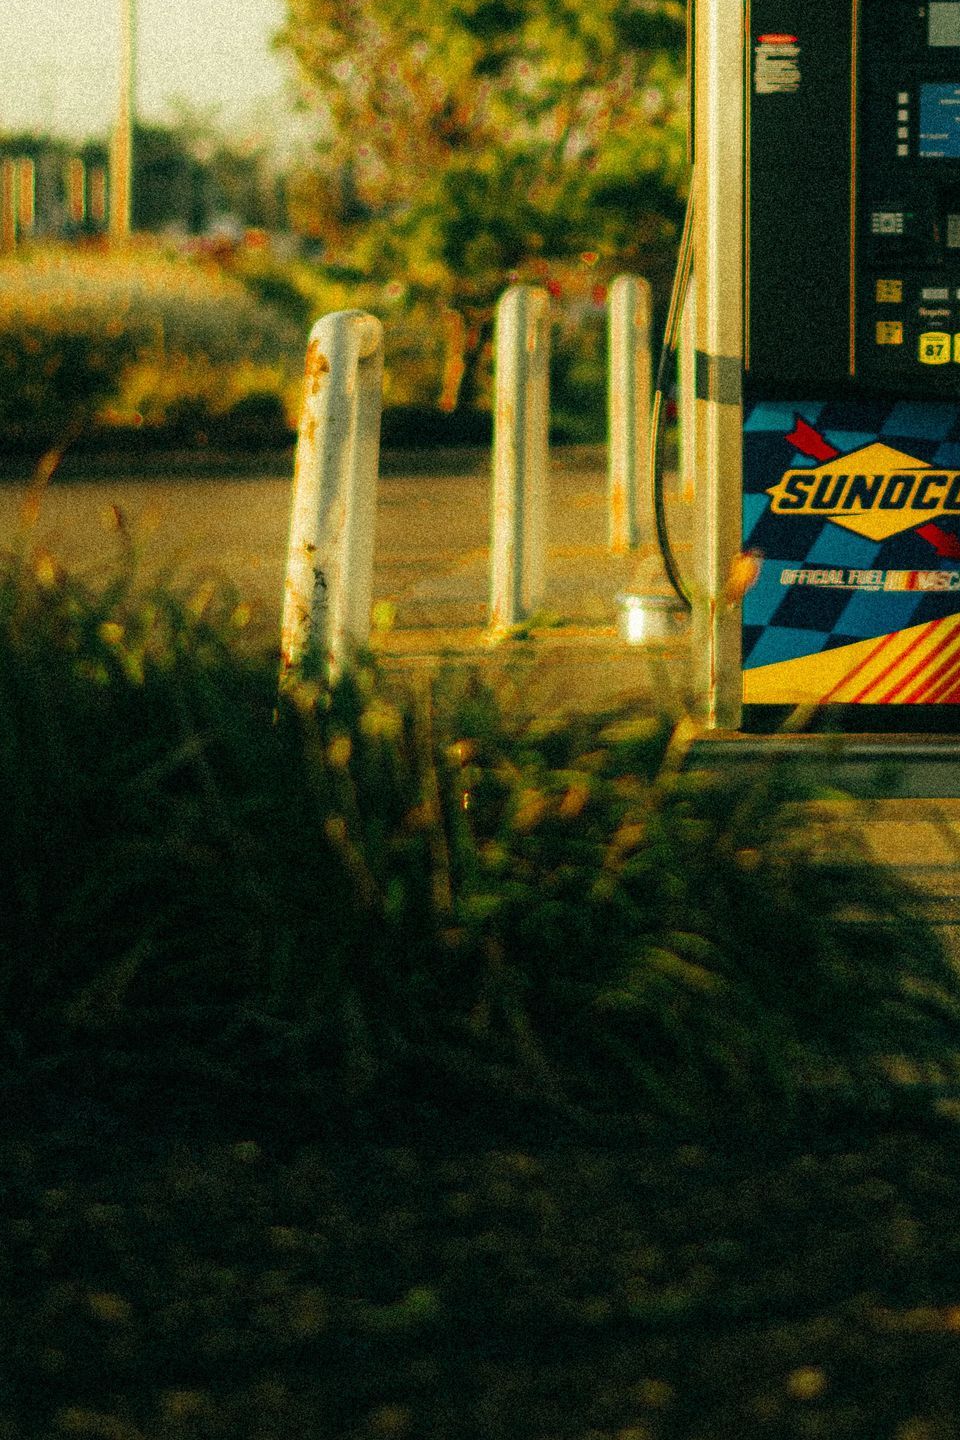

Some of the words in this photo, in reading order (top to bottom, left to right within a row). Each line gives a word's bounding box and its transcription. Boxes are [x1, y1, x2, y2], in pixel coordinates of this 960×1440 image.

[925, 344, 944, 357] 87
[780, 569, 845, 585] OFFICIAL
[848, 569, 884, 585] FUEL
